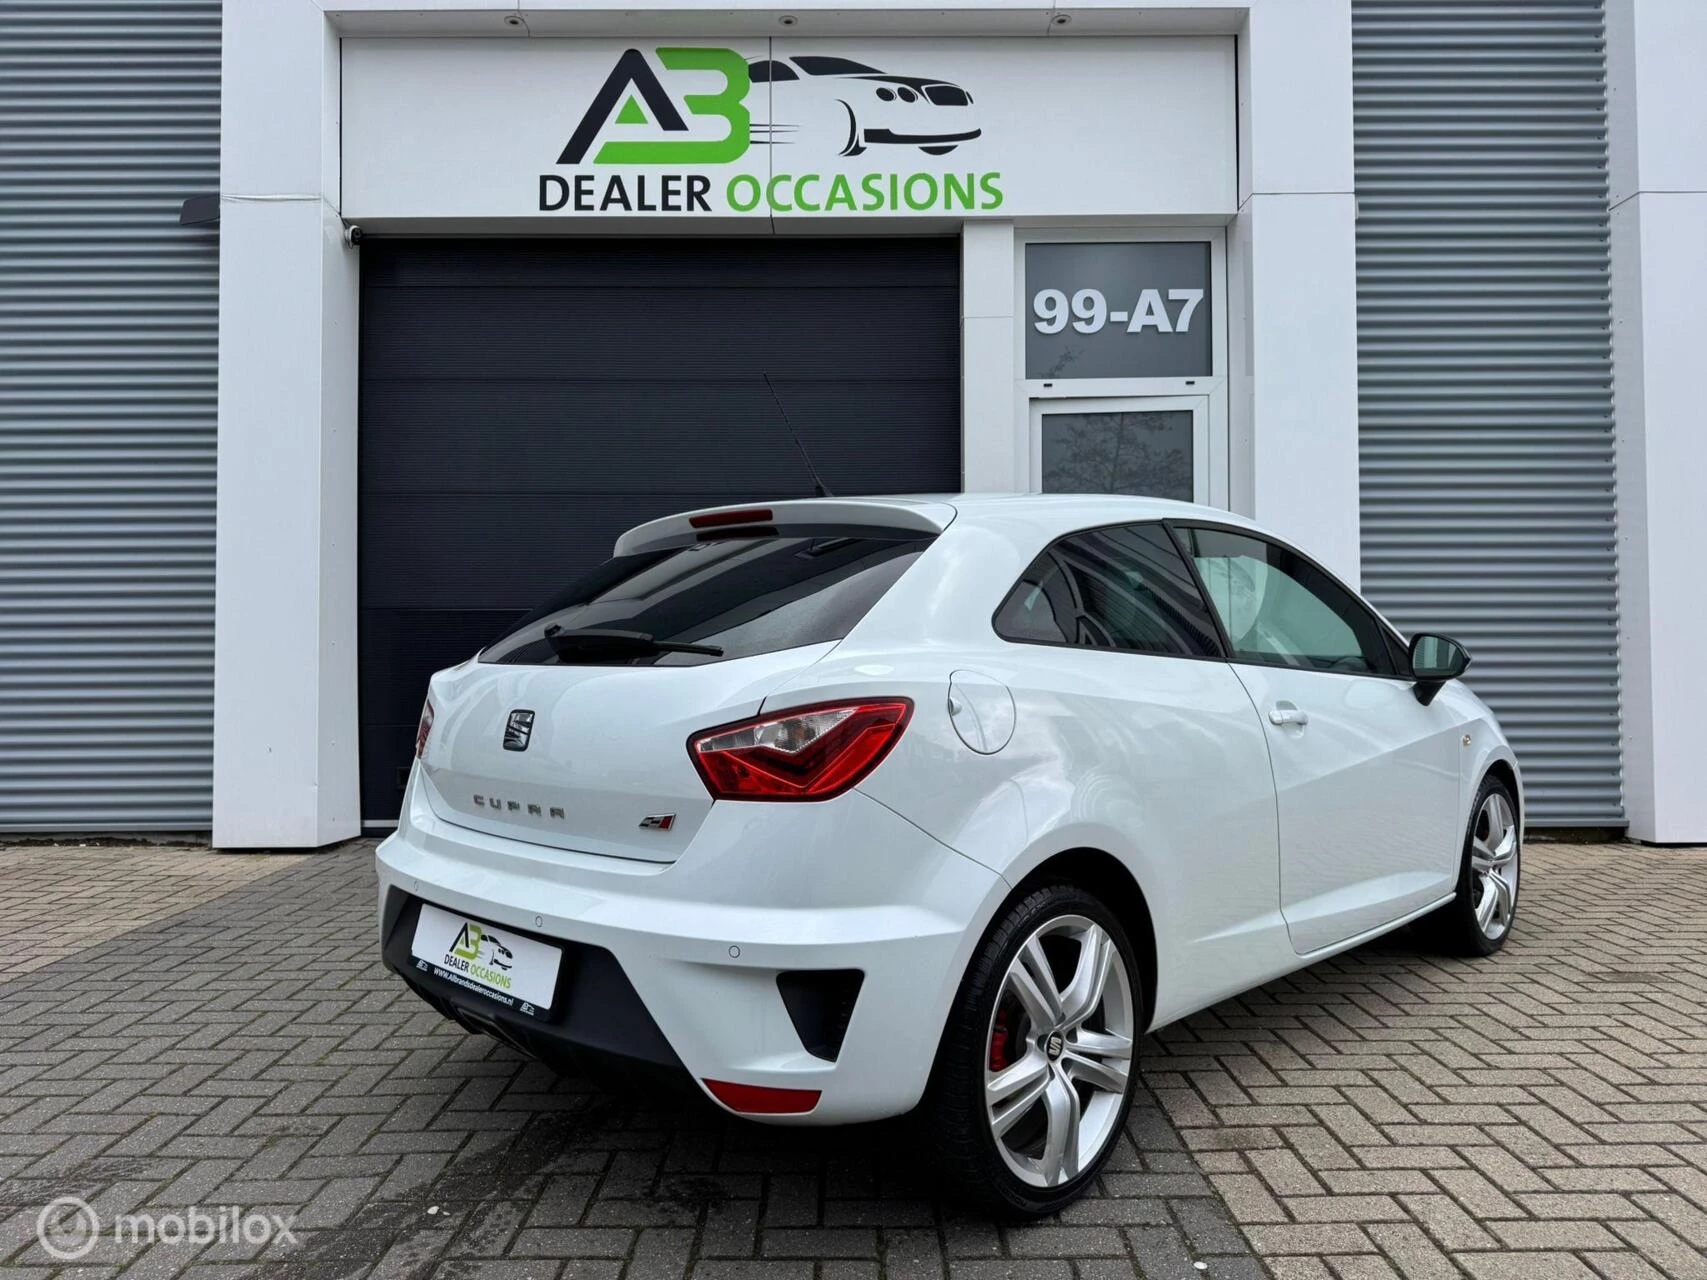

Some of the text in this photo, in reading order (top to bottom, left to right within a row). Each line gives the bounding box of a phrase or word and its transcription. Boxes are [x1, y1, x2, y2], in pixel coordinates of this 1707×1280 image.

[539, 172, 1003, 212] DEALER OCCASIONS
[1033, 288, 1204, 334] 99-A7
[473, 794, 565, 819] CUPRA
[444, 954, 469, 973] DEALER
[470, 964, 512, 990] OCCASIONS
